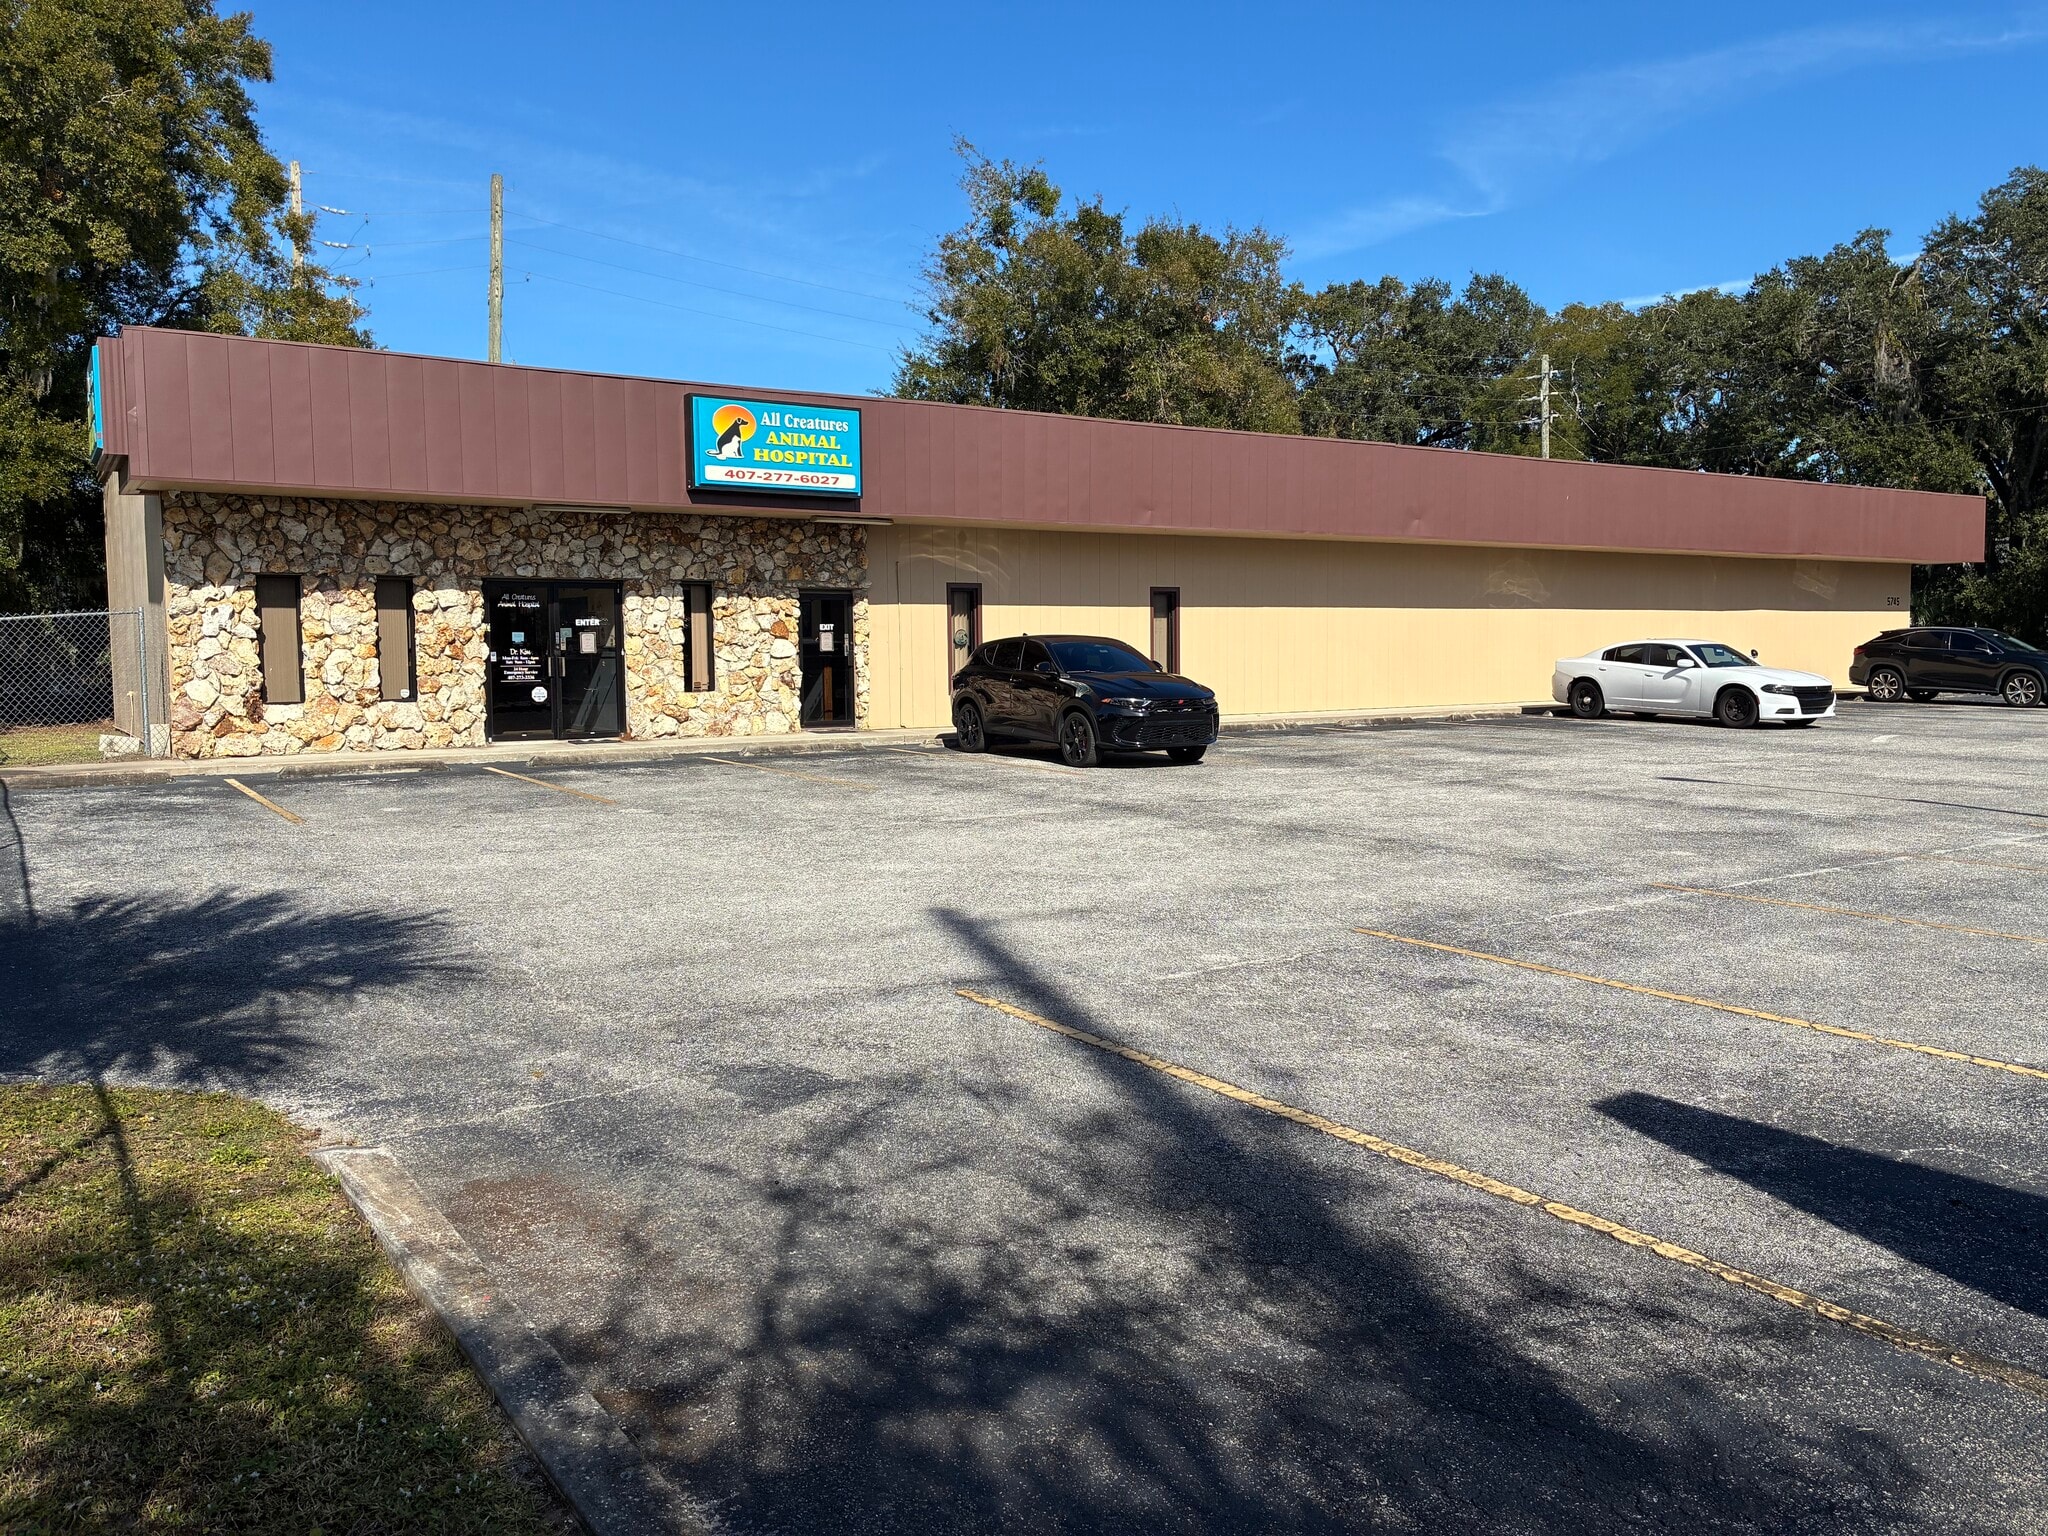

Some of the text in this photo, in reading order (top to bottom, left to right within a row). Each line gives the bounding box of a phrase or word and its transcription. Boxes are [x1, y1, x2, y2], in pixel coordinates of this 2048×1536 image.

[761, 412, 849, 432] All Creatures
[766, 431, 841, 450] ANIMAL
[754, 448, 852, 467] HOSPITAL
[725, 469, 840, 485] 407-277-6027
[1887, 597, 1900, 606] 5745
[575, 618, 600, 626] ENTER
